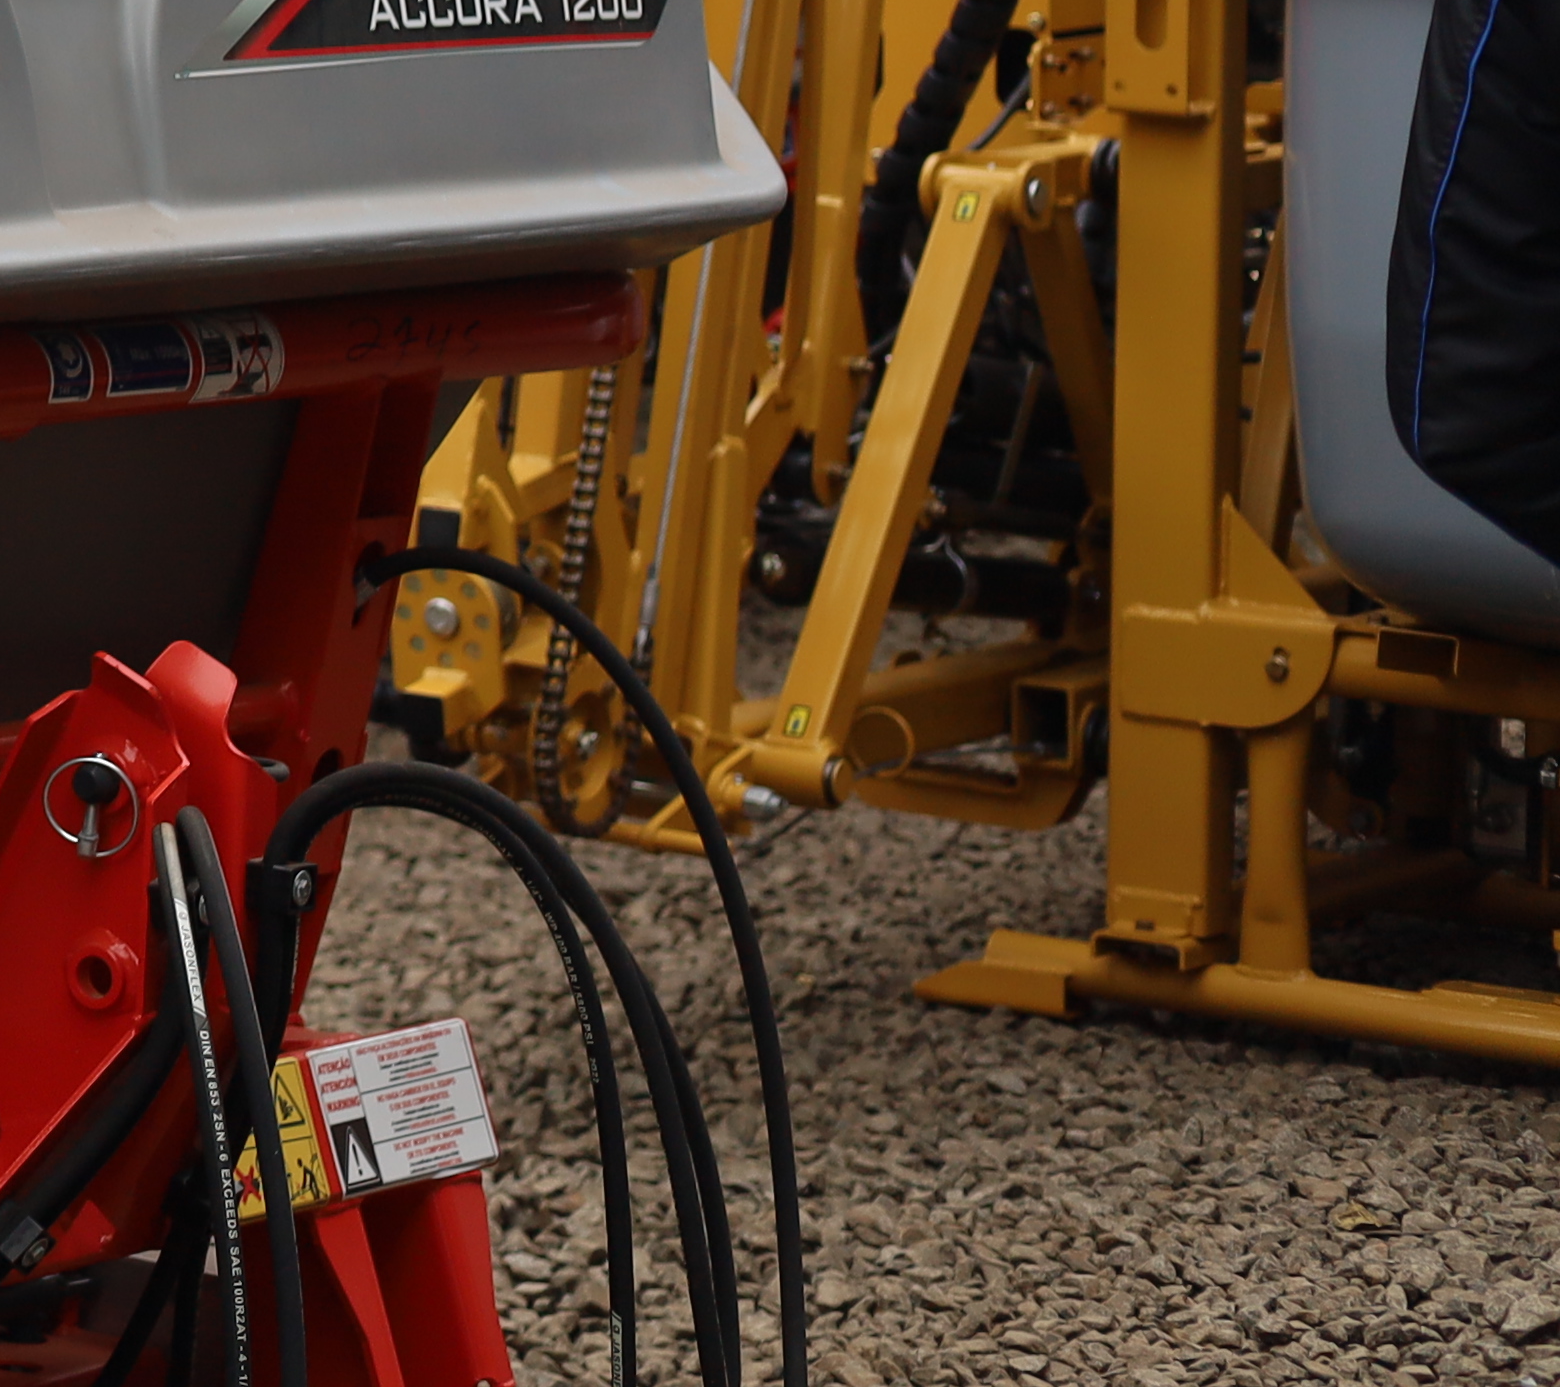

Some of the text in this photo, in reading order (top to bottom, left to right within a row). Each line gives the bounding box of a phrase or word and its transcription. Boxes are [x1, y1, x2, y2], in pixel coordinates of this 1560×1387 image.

[180, 923, 204, 1003] JASONFLEX
[199, 1029, 212, 1057] DIN
[203, 1058, 216, 1079] EN
[318, 1056, 352, 1075] ATENÇÃO
[208, 1080, 221, 1107] 853
[213, 1112, 227, 1143] 2SN
[221, 1169, 239, 1240] EXCEEDS
[230, 1246, 243, 1277] SAE
[233, 1280, 248, 1344] 100R2AT
